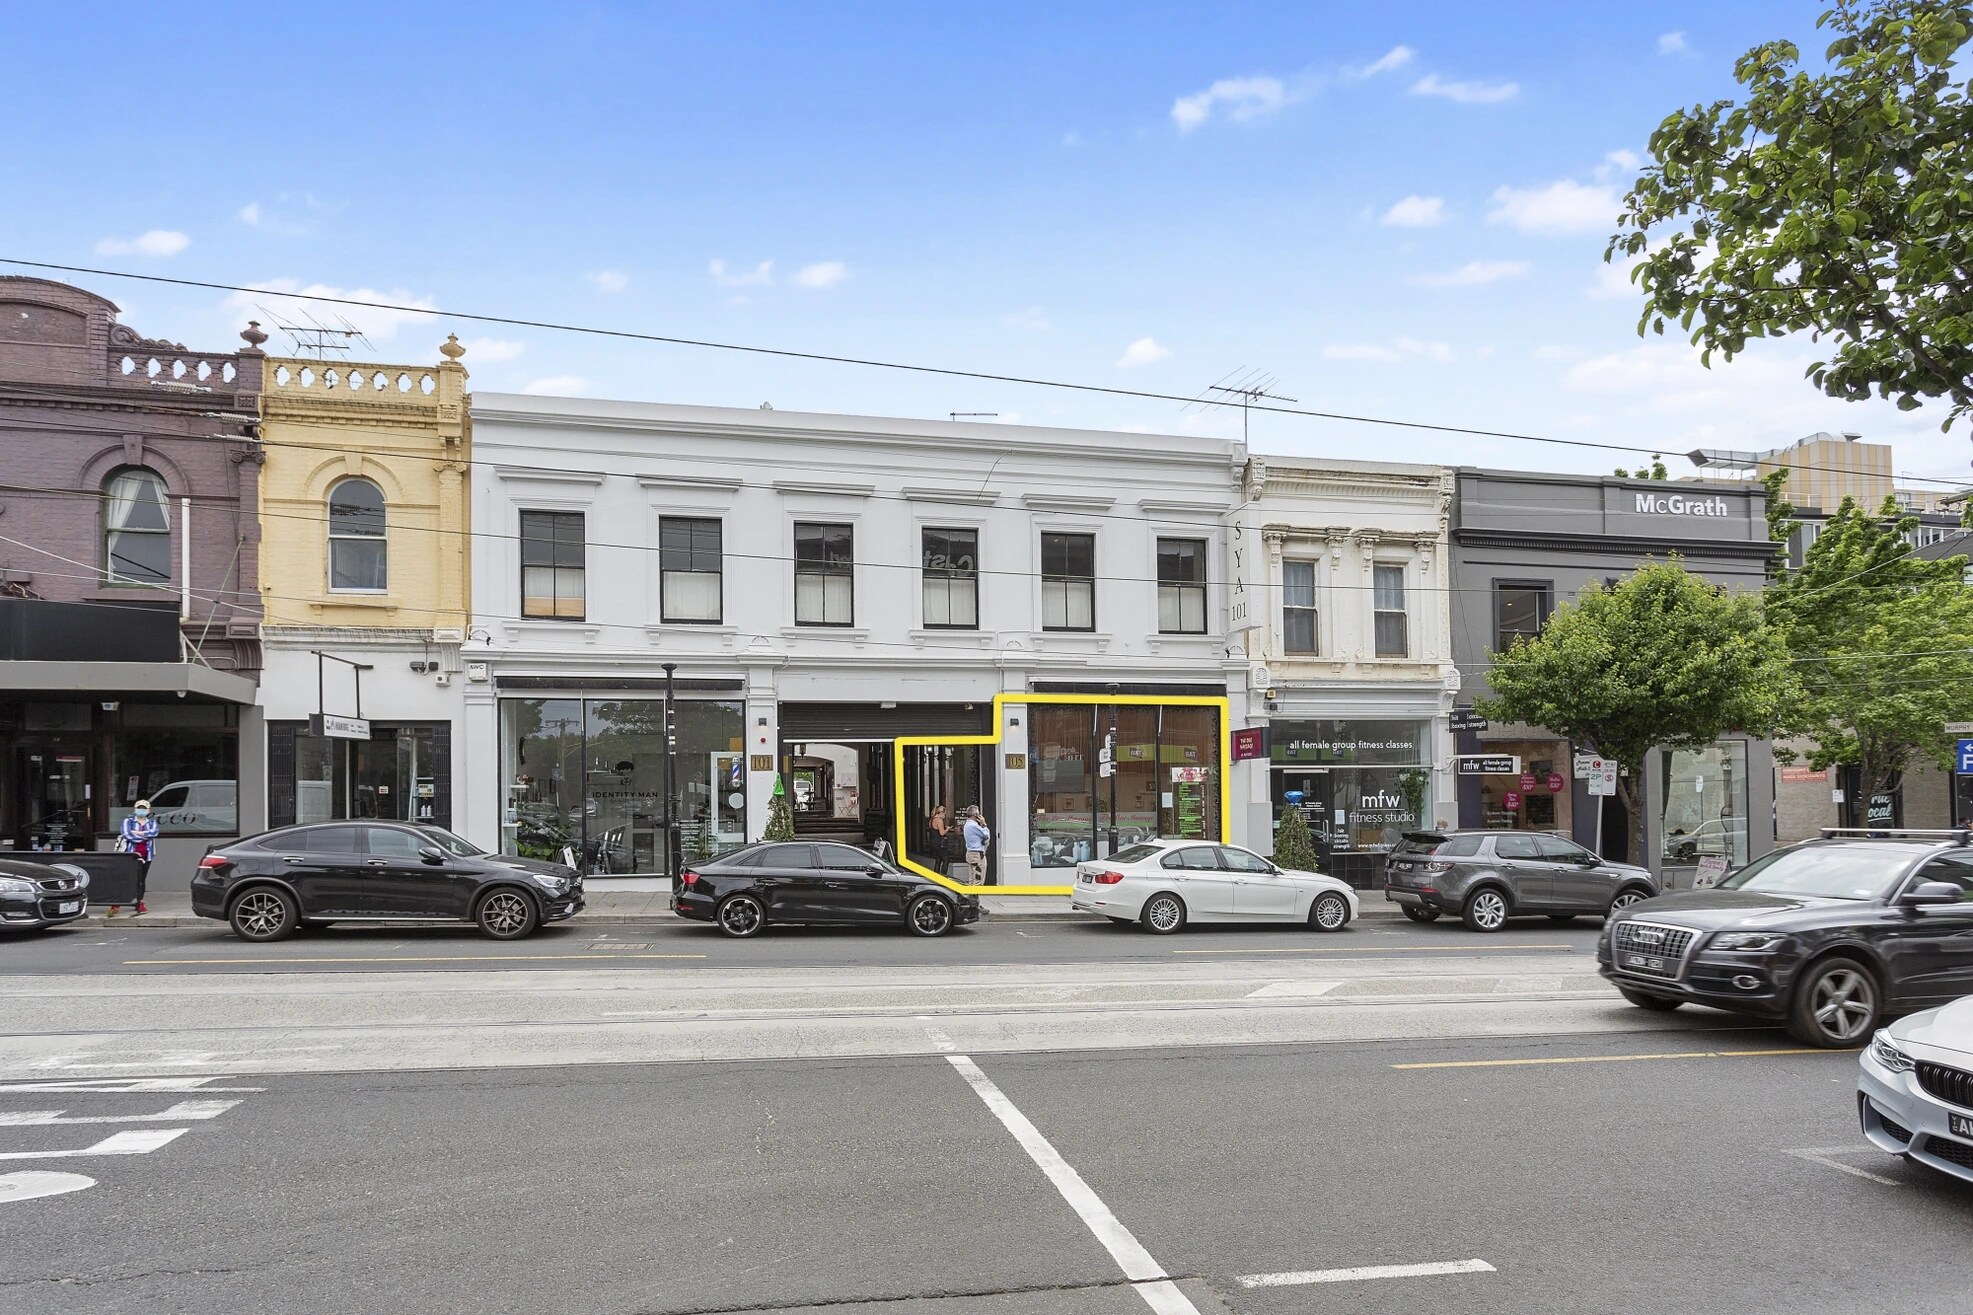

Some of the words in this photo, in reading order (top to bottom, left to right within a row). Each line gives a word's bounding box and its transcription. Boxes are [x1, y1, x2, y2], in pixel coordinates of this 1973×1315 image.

[1635, 494, 1728, 517] McGrath
[1232, 602, 1247, 621] 101
[1289, 740, 1299, 749] all
[1301, 739, 1330, 749] female
[1331, 742, 1356, 752] group
[1358, 739, 1384, 749] fitness
[1385, 739, 1413, 749] classes
[752, 756, 772, 770] 101
[1007, 757, 1024, 768] 105
[1463, 759, 1480, 770] mfw
[1362, 789, 1401, 808] mfw
[1349, 811, 1382, 823] fitness
[1385, 811, 1415, 823] studio
[1868, 803, 1892, 818] ocal
